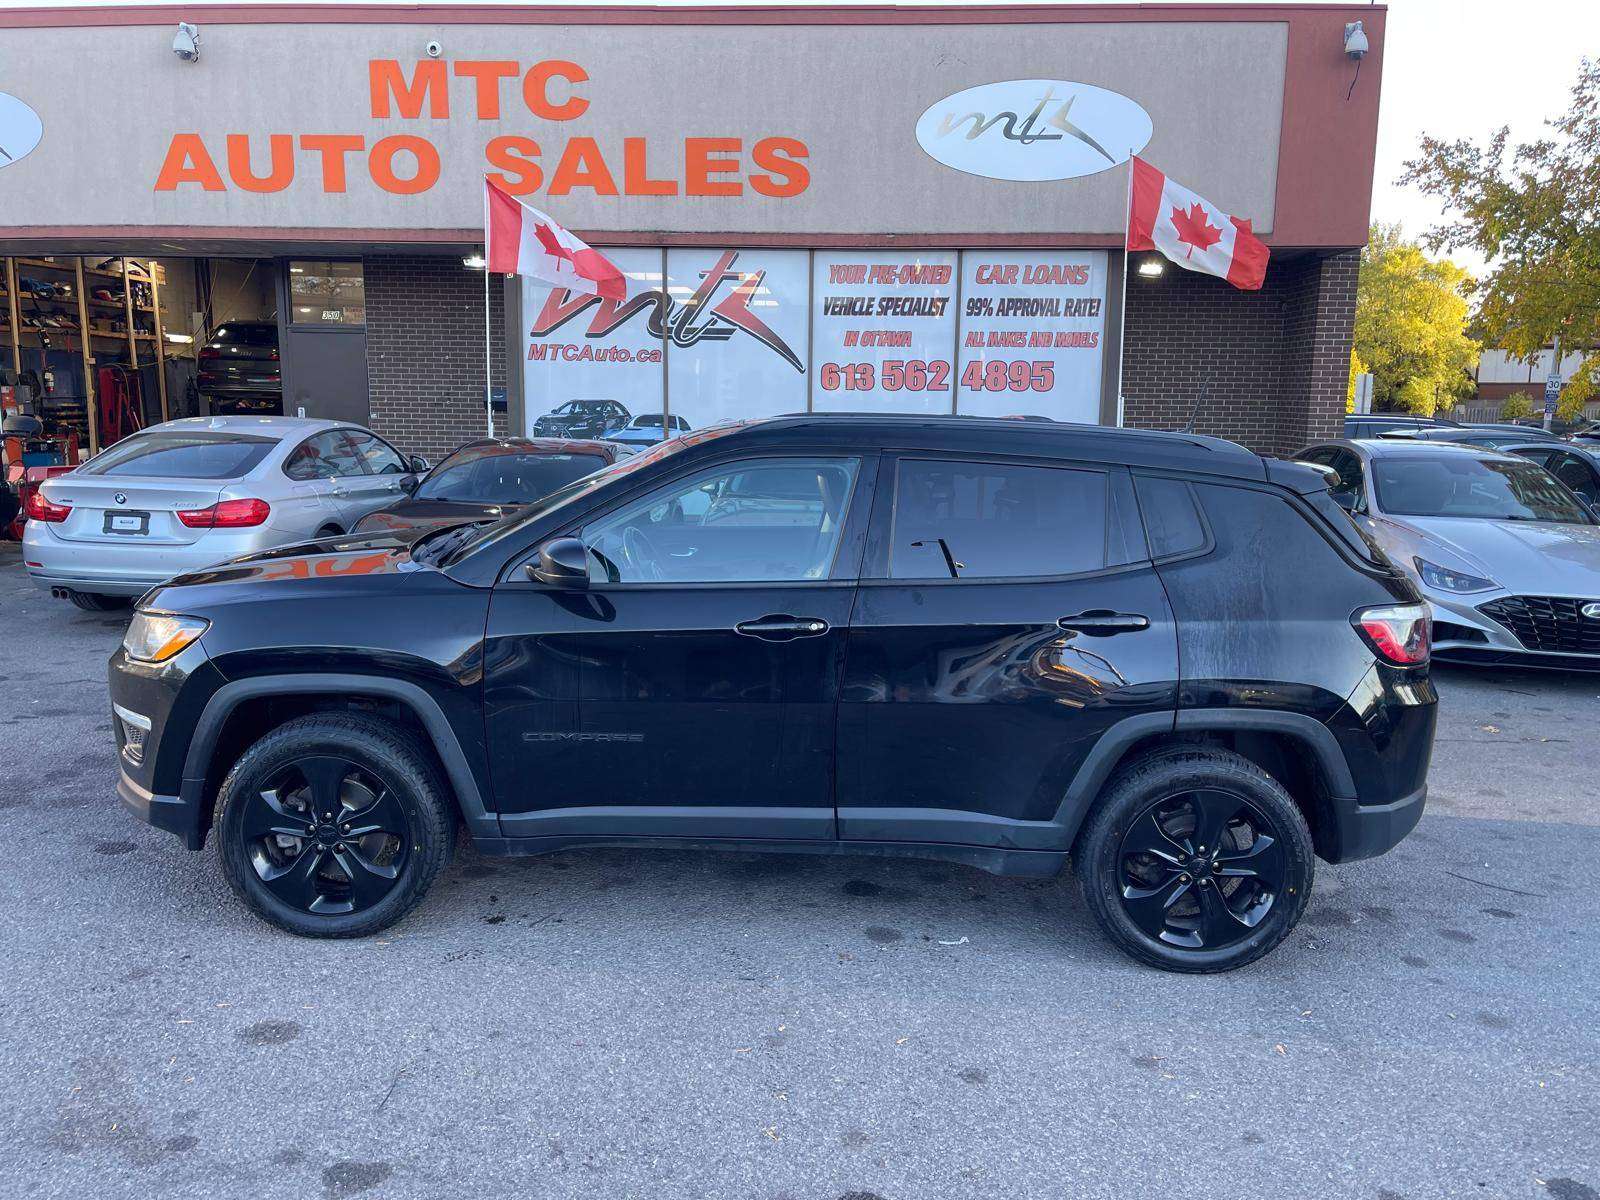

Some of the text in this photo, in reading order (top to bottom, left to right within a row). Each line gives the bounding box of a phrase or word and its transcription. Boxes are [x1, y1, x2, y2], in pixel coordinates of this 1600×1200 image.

[369, 59, 590, 121] MTC
[154, 134, 811, 198] AUTO SALES
[829, 264, 952, 285] YOUR PRE-OWNED
[975, 264, 1090, 285] CAR LOANS
[824, 296, 950, 317] VEHICLE SPECIALIST
[966, 297, 1101, 317] 99% APPROVAL RATE!
[844, 330, 912, 347] IN OTTAWA
[965, 331, 1099, 348] ALL MAKES AND MODELS
[527, 343, 663, 363] MTCAuto.ca
[820, 360, 1055, 392] 613 562 4895
[1548, 380, 1560, 389] 30
